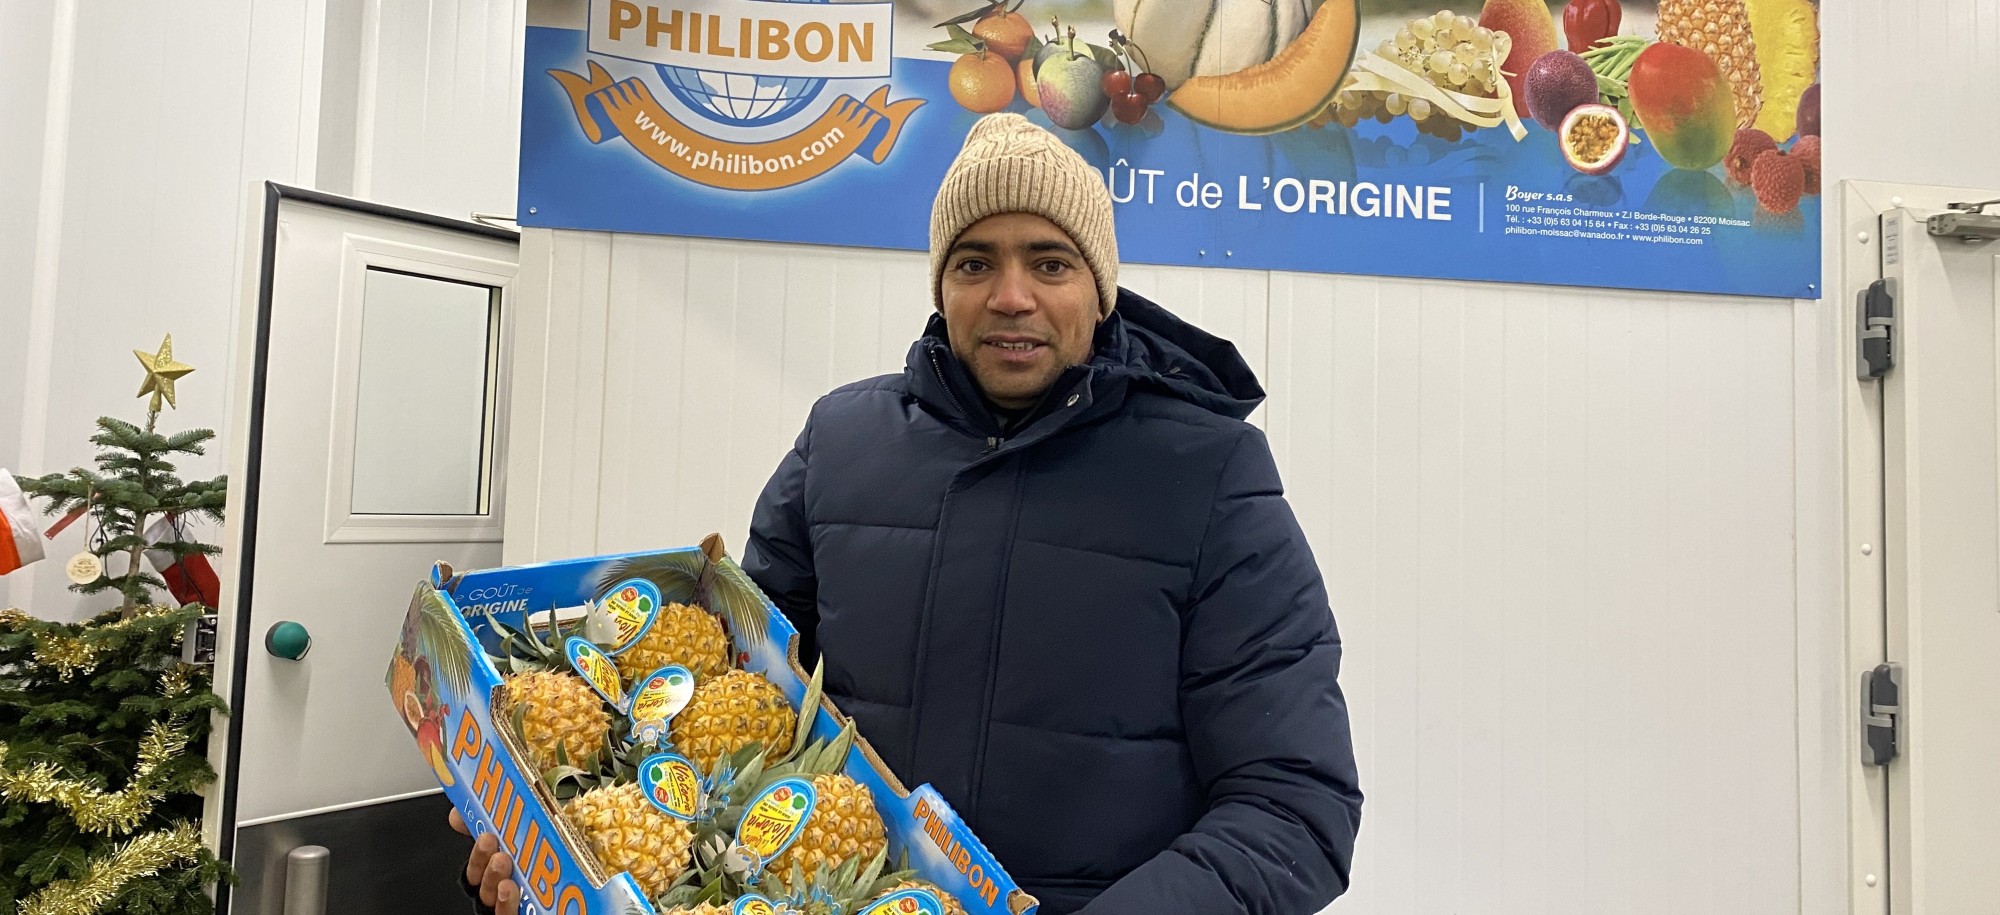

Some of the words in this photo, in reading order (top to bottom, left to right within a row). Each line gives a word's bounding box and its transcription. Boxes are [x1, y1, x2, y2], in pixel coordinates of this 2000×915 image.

[608, 0, 875, 63] PHILIBON
[633, 110, 845, 178] www.philibon.com
[1089, 158, 1165, 205] ÛT
[1176, 172, 1223, 209] de
[1238, 175, 1452, 221] L'ORIGINE
[1505, 185, 1544, 202] Boyer
[1546, 192, 1573, 202] s.a.s
[1505, 204, 1521, 213] 100
[1522, 206, 1535, 214] rue
[1537, 205, 1571, 217] François
[1573, 207, 1614, 219] Charmeux
[1621, 211, 1632, 219] Z.I
[1634, 211, 1686, 224] Borde-Rouge
[1693, 215, 1717, 225] 82200
[1718, 217, 1751, 227] Moissac
[1526, 216, 1542, 225] +33
[1543, 217, 1559, 227] (0)5
[1560, 218, 1571, 226] 63
[1572, 218, 1582, 227] 04
[1584, 219, 1594, 228] 15
[1595, 219, 1605, 228] 64
[1613, 221, 1629, 230] Fax
[1634, 222, 1649, 231] +33
[1651, 223, 1666, 234] (0)5
[1667, 224, 1677, 233] 63
[1678, 225, 1688, 234] 04
[1690, 226, 1700, 235] 26
[1701, 226, 1711, 235] 25
[1505, 225, 1624, 241] philibon-moissac@wanadoo.fr
[1632, 233, 1703, 246] www.philibon.com
[468, 583, 519, 601] GOÛT
[460, 598, 529, 619] ORIGINE
[451, 705, 588, 915] PHILIBO
[912, 795, 1000, 908] PHILIBON
